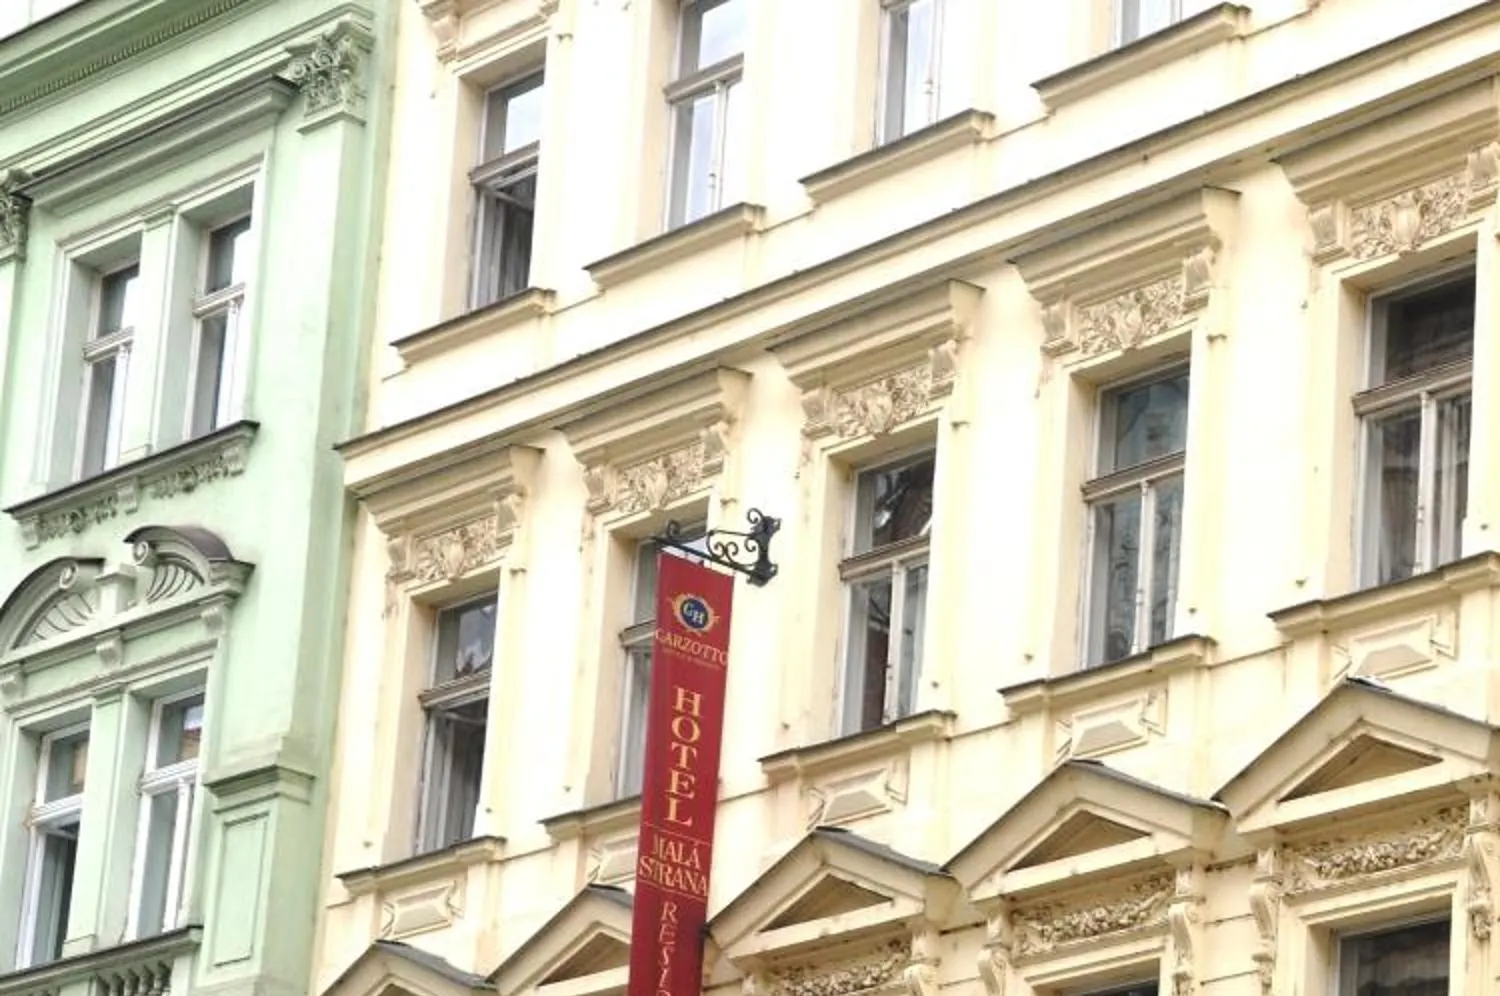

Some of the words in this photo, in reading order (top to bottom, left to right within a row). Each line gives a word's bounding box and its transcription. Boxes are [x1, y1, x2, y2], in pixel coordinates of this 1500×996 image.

[664, 685, 702, 827] HOTEL
[652, 832, 701, 870] MALÁ
[639, 854, 708, 898] STRANA
